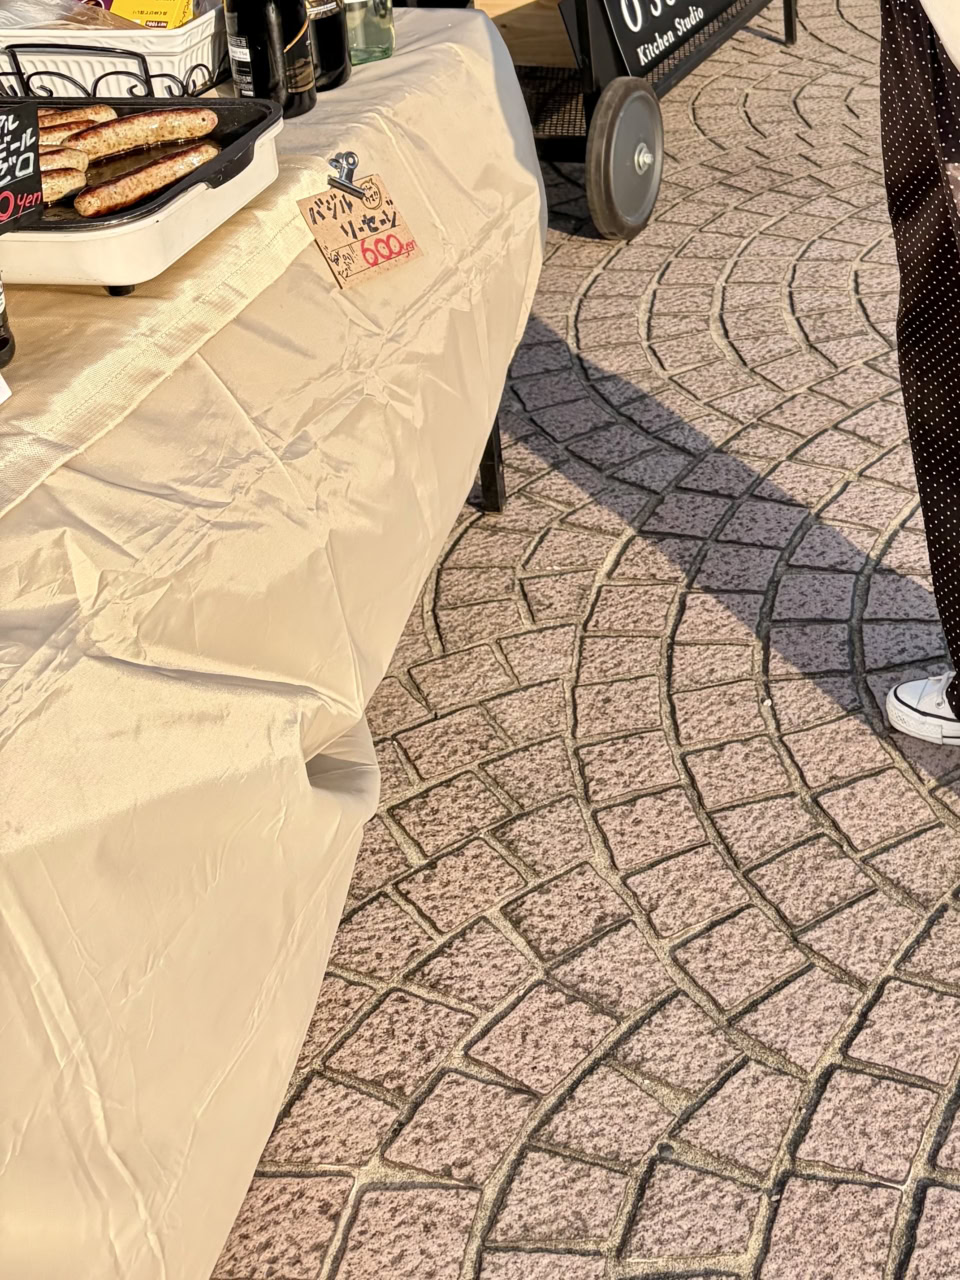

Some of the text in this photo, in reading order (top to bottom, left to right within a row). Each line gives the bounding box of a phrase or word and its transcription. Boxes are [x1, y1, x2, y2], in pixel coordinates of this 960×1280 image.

[636, 6, 705, 67] Kitchen Studio
[309, 193, 354, 226] バジル
